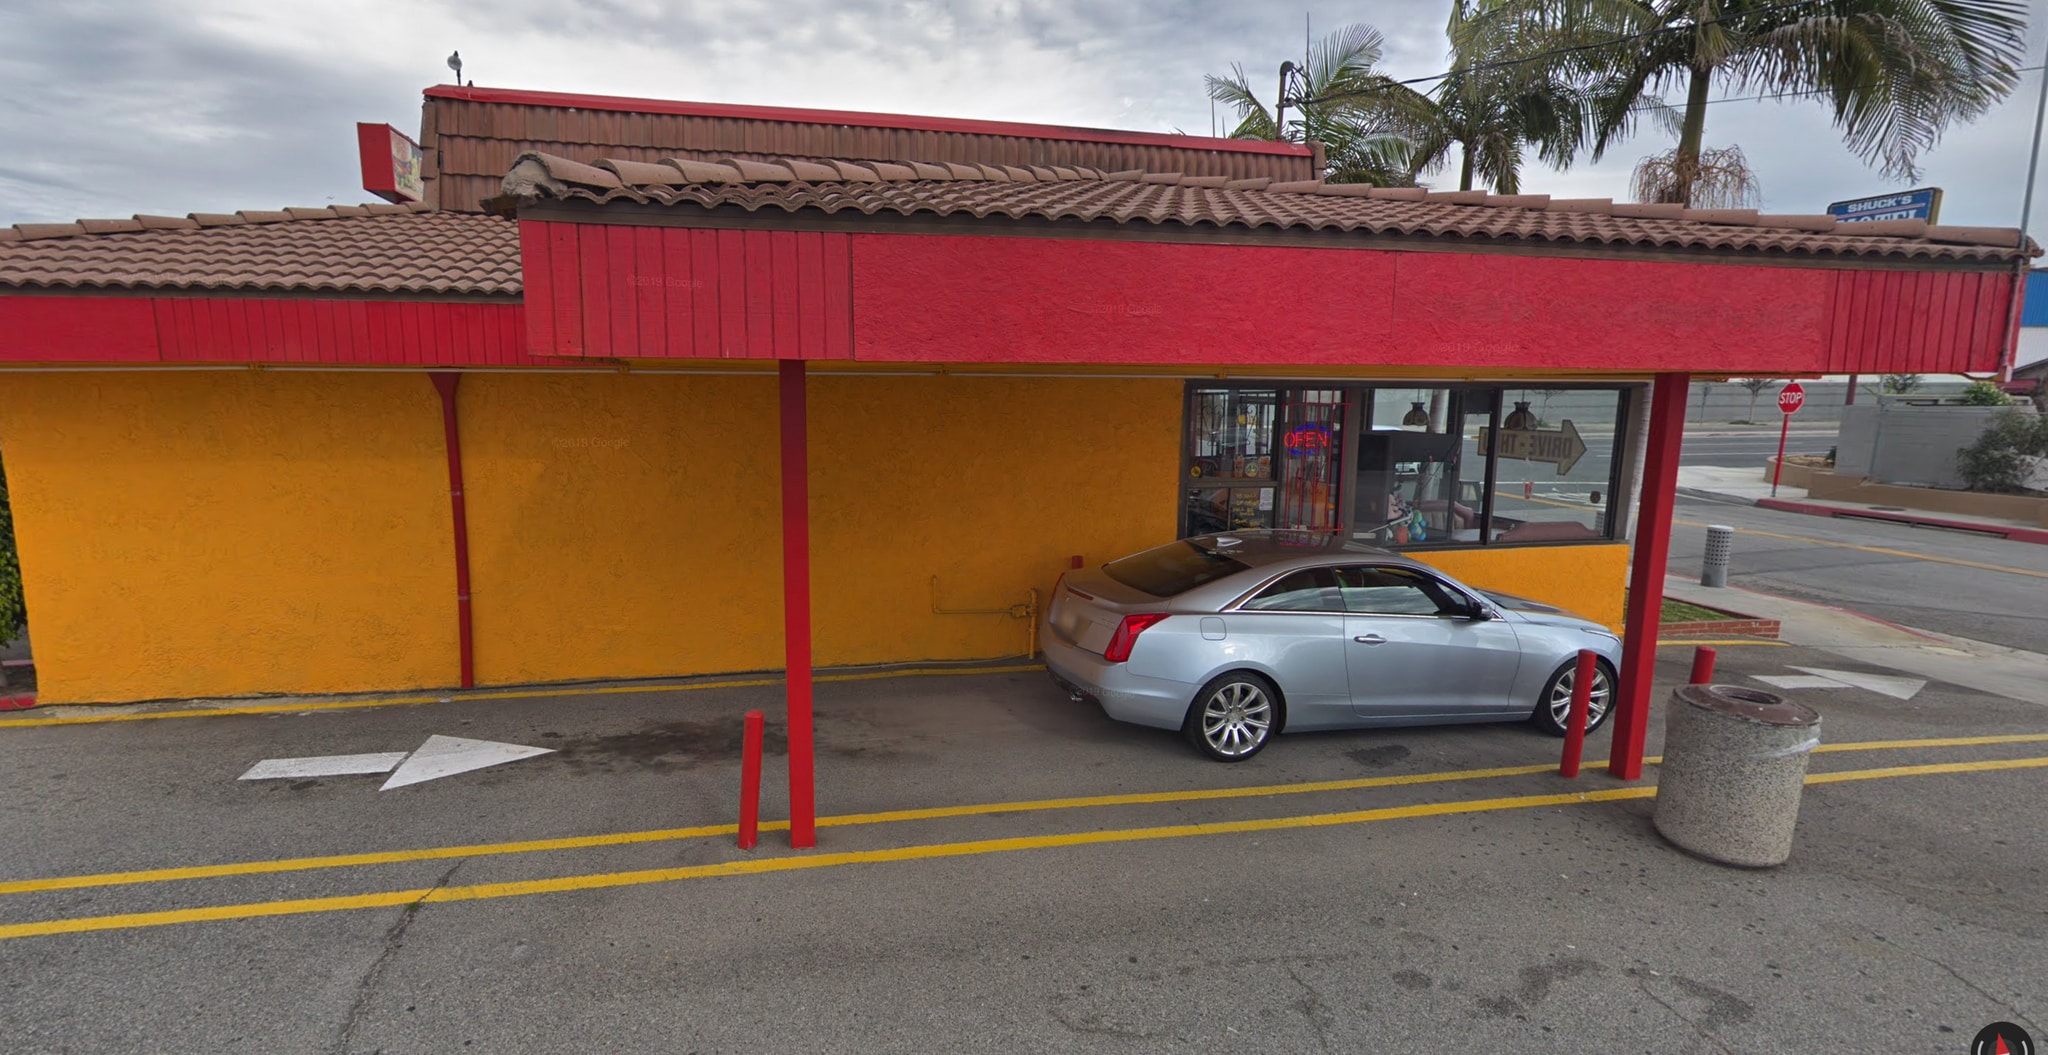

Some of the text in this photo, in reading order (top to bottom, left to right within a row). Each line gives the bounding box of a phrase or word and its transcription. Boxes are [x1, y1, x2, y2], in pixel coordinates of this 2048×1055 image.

[1847, 195, 1912, 213] SHUCK'S
[1779, 391, 1802, 405] STOP
[1283, 431, 1329, 448] OPEN
